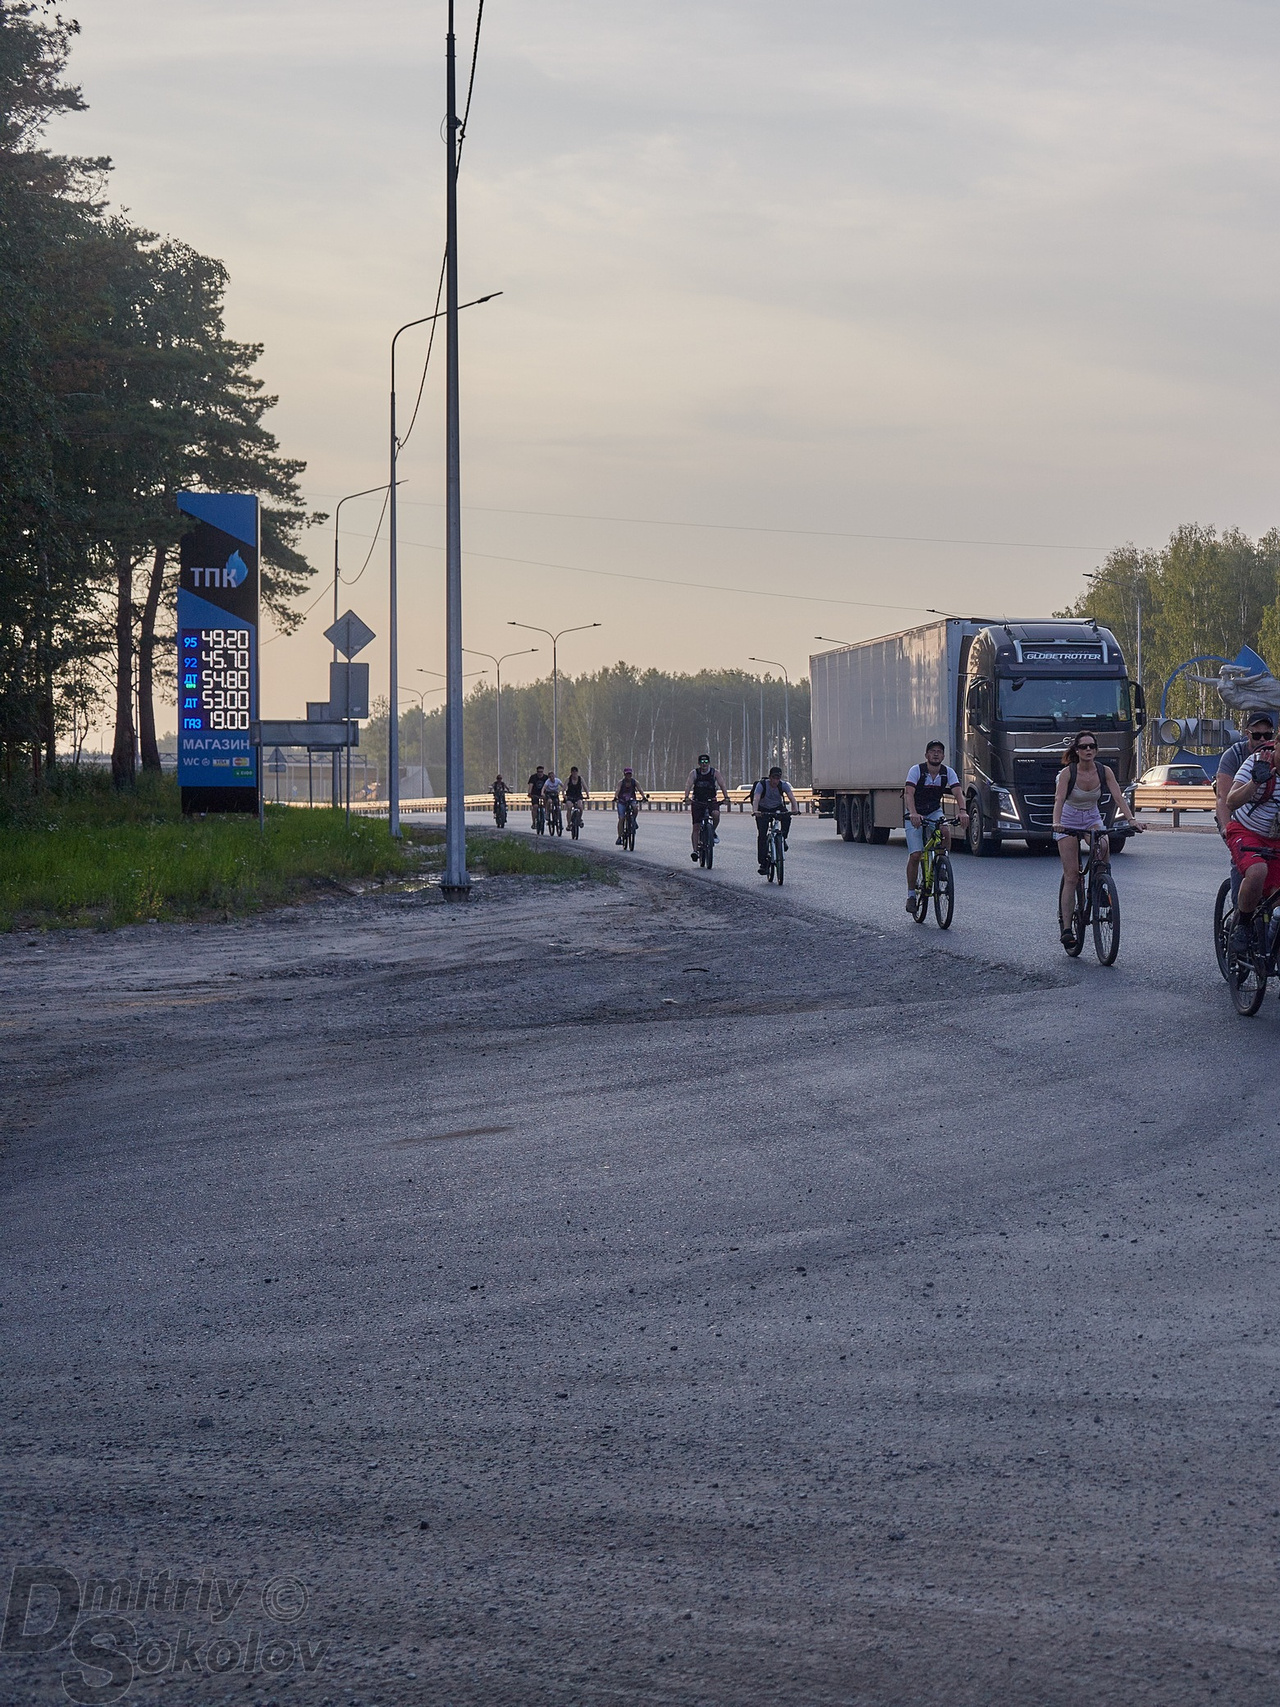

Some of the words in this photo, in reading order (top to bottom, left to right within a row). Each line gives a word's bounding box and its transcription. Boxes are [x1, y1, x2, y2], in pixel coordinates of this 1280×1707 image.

[190, 567, 237, 588] ТПК
[184, 637, 198, 648] 95
[201, 630, 249, 649] 49.20
[184, 657, 198, 668] 92
[201, 650, 249, 669] 45.70
[184, 674, 198, 684] ДТ
[201, 670, 249, 689] 54.80
[184, 698, 198, 709] ДТ
[201, 690, 249, 709] 53.00
[184, 718, 202, 729] ГАЗ
[210, 711, 249, 730] 19.00
[183, 739, 250, 750] МАГАЗИН
[183, 757, 200, 766] WC
